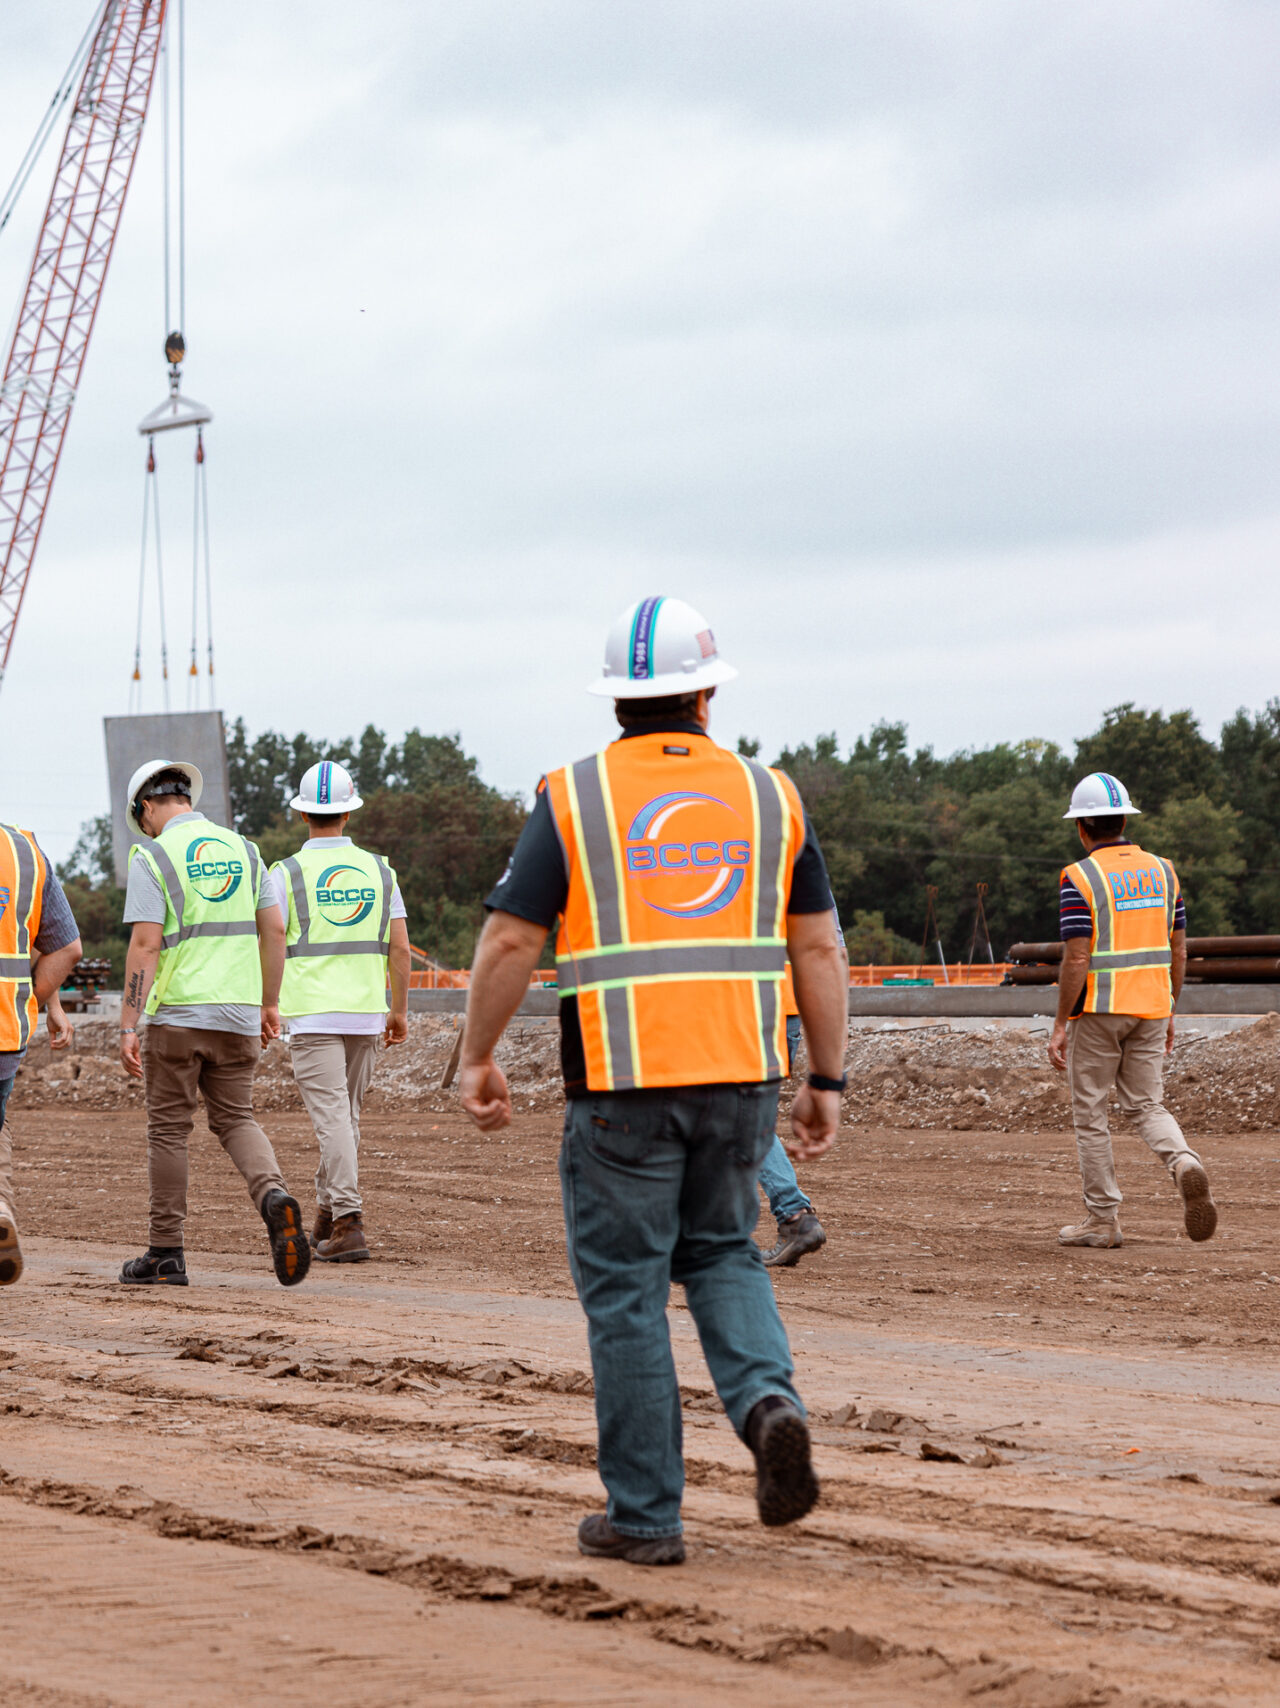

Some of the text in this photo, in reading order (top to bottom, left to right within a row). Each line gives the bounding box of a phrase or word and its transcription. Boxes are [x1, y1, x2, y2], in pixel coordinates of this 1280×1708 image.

[635, 642, 646, 663] 988
[627, 840, 750, 871] BCCG
[186, 861, 243, 878] BCCG
[1108, 867, 1163, 899] BCCG
[316, 888, 376, 903] BCCG
